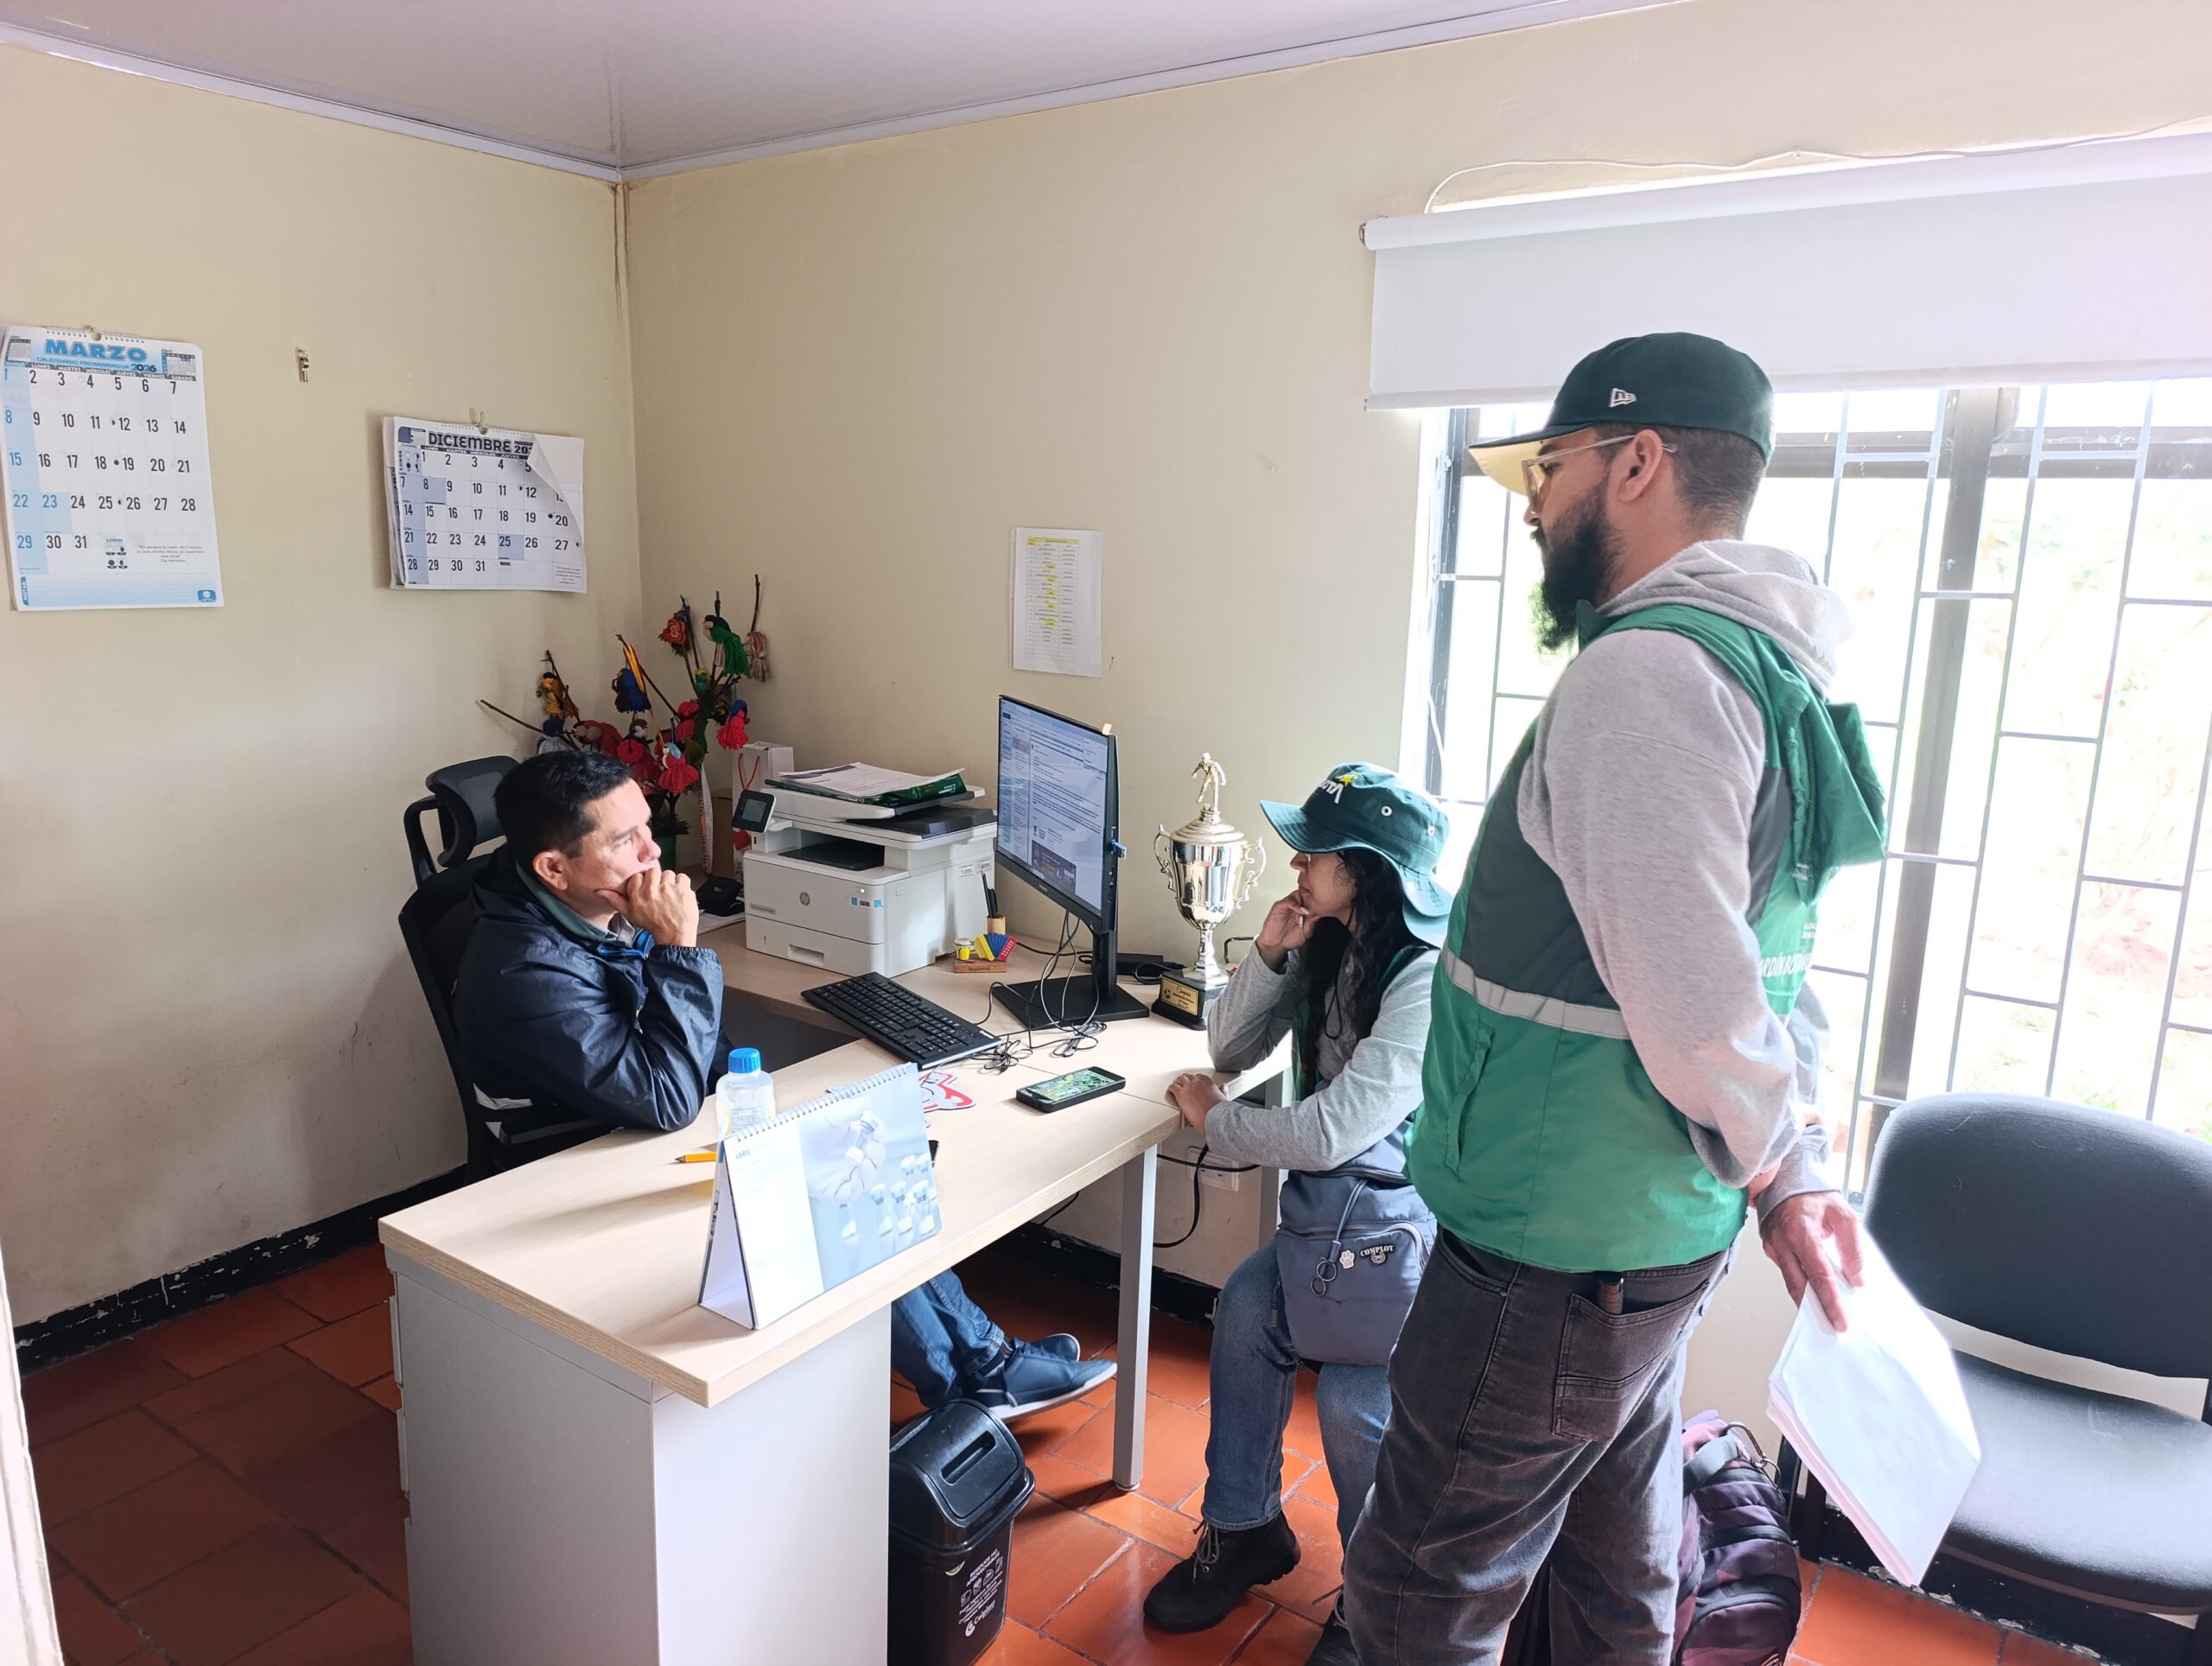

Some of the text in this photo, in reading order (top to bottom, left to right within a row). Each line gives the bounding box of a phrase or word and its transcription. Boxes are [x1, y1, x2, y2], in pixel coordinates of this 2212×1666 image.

[45, 339, 147, 363] MARZO
[36, 356, 79, 366] CALENDARIO
[130, 364, 157, 372] 2026
[29, 370, 37, 384] 2
[57, 372, 66, 385] 3
[86, 375, 94, 388] 4
[114, 377, 122, 391] 5
[142, 378, 149, 392] 6
[170, 381, 176, 394] 7
[5, 410, 187, 434] 8 9 10 11 12 13 14
[428, 432, 512, 453] DICIEMBRE
[9, 452, 190, 473] 15 16 17 18 19 20 21
[422, 451, 531, 473] 1 2 3 4 5
[400, 476, 405, 487] 7
[423, 479, 429, 490] 8
[447, 480, 453, 493] 9
[473, 482, 482, 494] 10
[499, 484, 506, 496] 11
[525, 487, 537, 498] 12
[13, 494, 196, 512] 22 23 24 25 26 27 28
[404, 504, 569, 527] 14 15 16 17 18 19 20
[17, 535, 88, 550] 29 30 31
[404, 531, 569, 550] 21 22 23 24 25 26 27
[408, 558, 486, 572] 28 29 30 31
[800, 892, 810, 906] hp
[1360, 1244, 1394, 1257] COMPLOT
